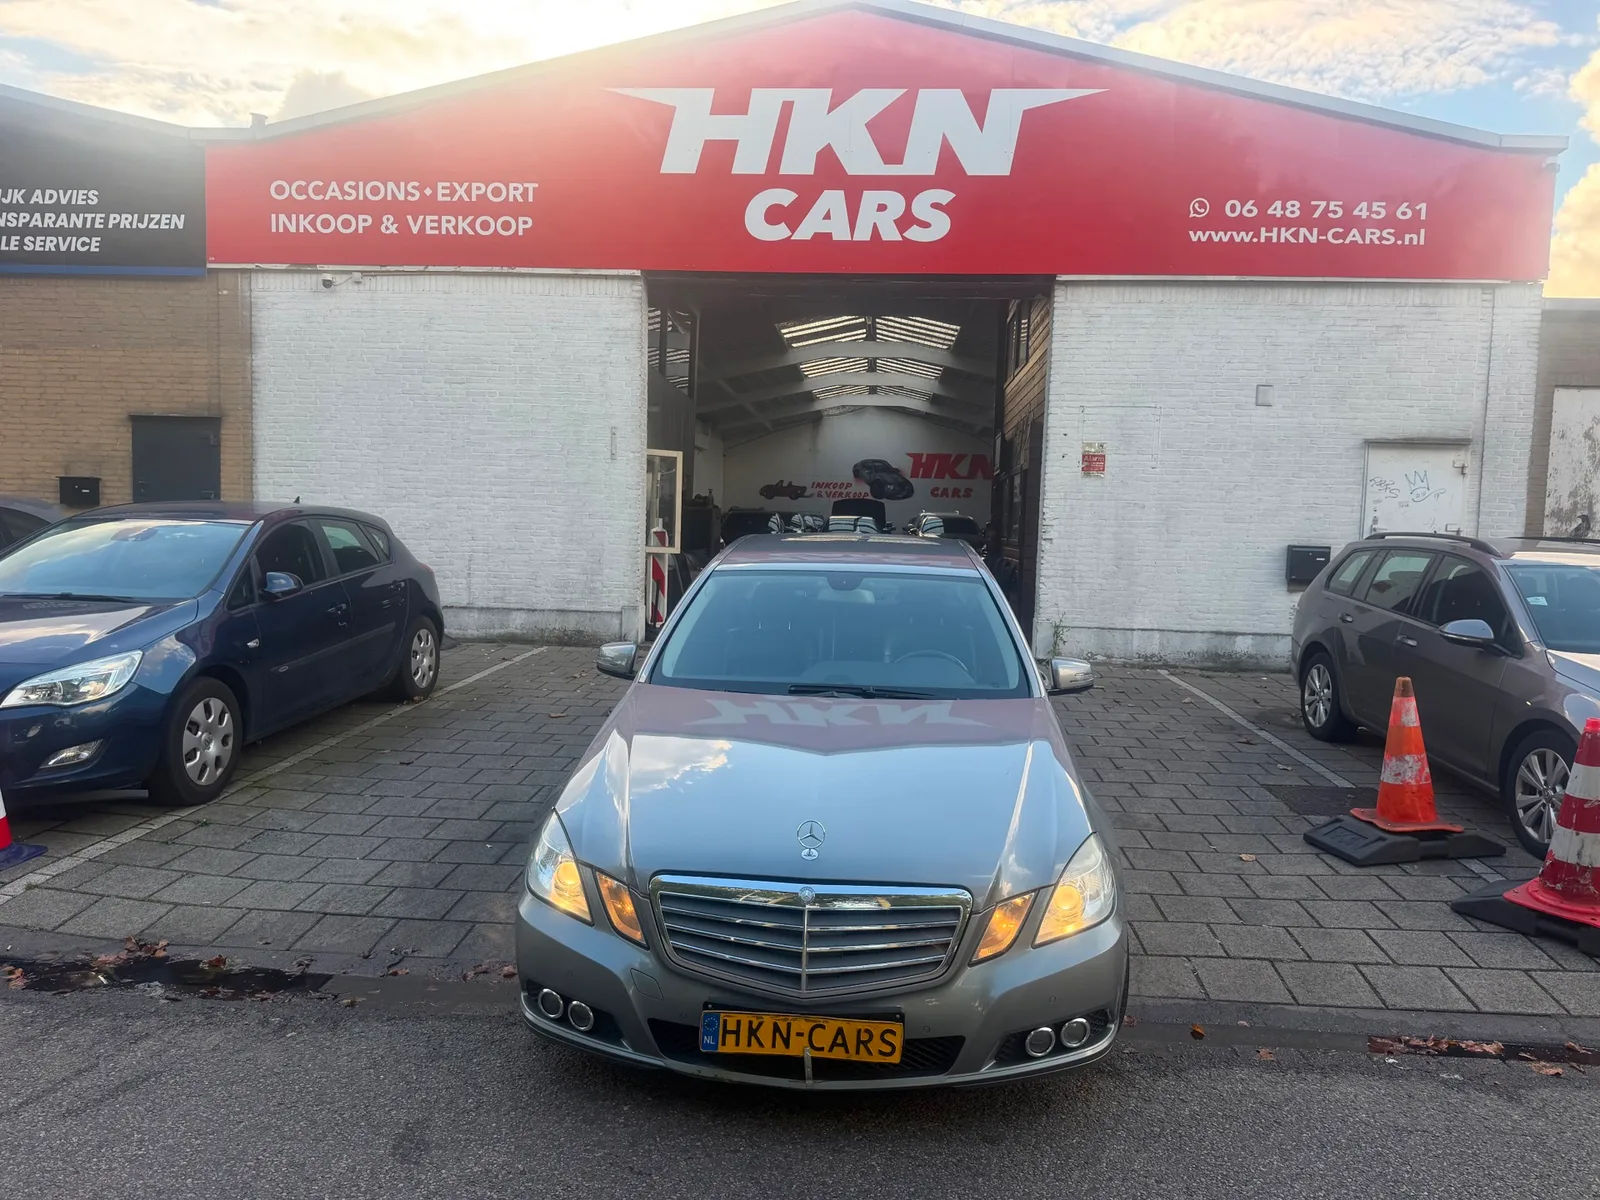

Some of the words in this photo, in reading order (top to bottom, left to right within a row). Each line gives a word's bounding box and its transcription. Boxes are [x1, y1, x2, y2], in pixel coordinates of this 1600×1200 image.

[602, 87, 1110, 176] HKN
[0, 188, 26, 204] JK
[30, 189, 99, 205] ADVIES
[269, 179, 420, 201] OCCASIONS
[437, 181, 538, 203] EXPORT
[745, 187, 957, 243] CARS
[1225, 199, 1259, 218] 06
[1267, 200, 1301, 218] 48
[1310, 200, 1344, 219] 75
[1353, 201, 1387, 220] 45
[1396, 202, 1428, 220] 61
[108, 213, 185, 230] PRIJZEN
[270, 213, 373, 234] INKOOP
[380, 214, 399, 235] &
[406, 215, 533, 236] VERKOOP
[23, 235, 101, 252] SERVICE
[1188, 226, 1426, 246] www.HKN-CARS.nl
[906, 452, 994, 480] HKN
[811, 481, 853, 491] INKOOP
[816, 490, 825, 499] &
[826, 490, 870, 500] VERKOOP
[930, 486, 973, 499] CARS
[703, 1035, 716, 1046] NL
[720, 1017, 898, 1058] HKN-CARS
